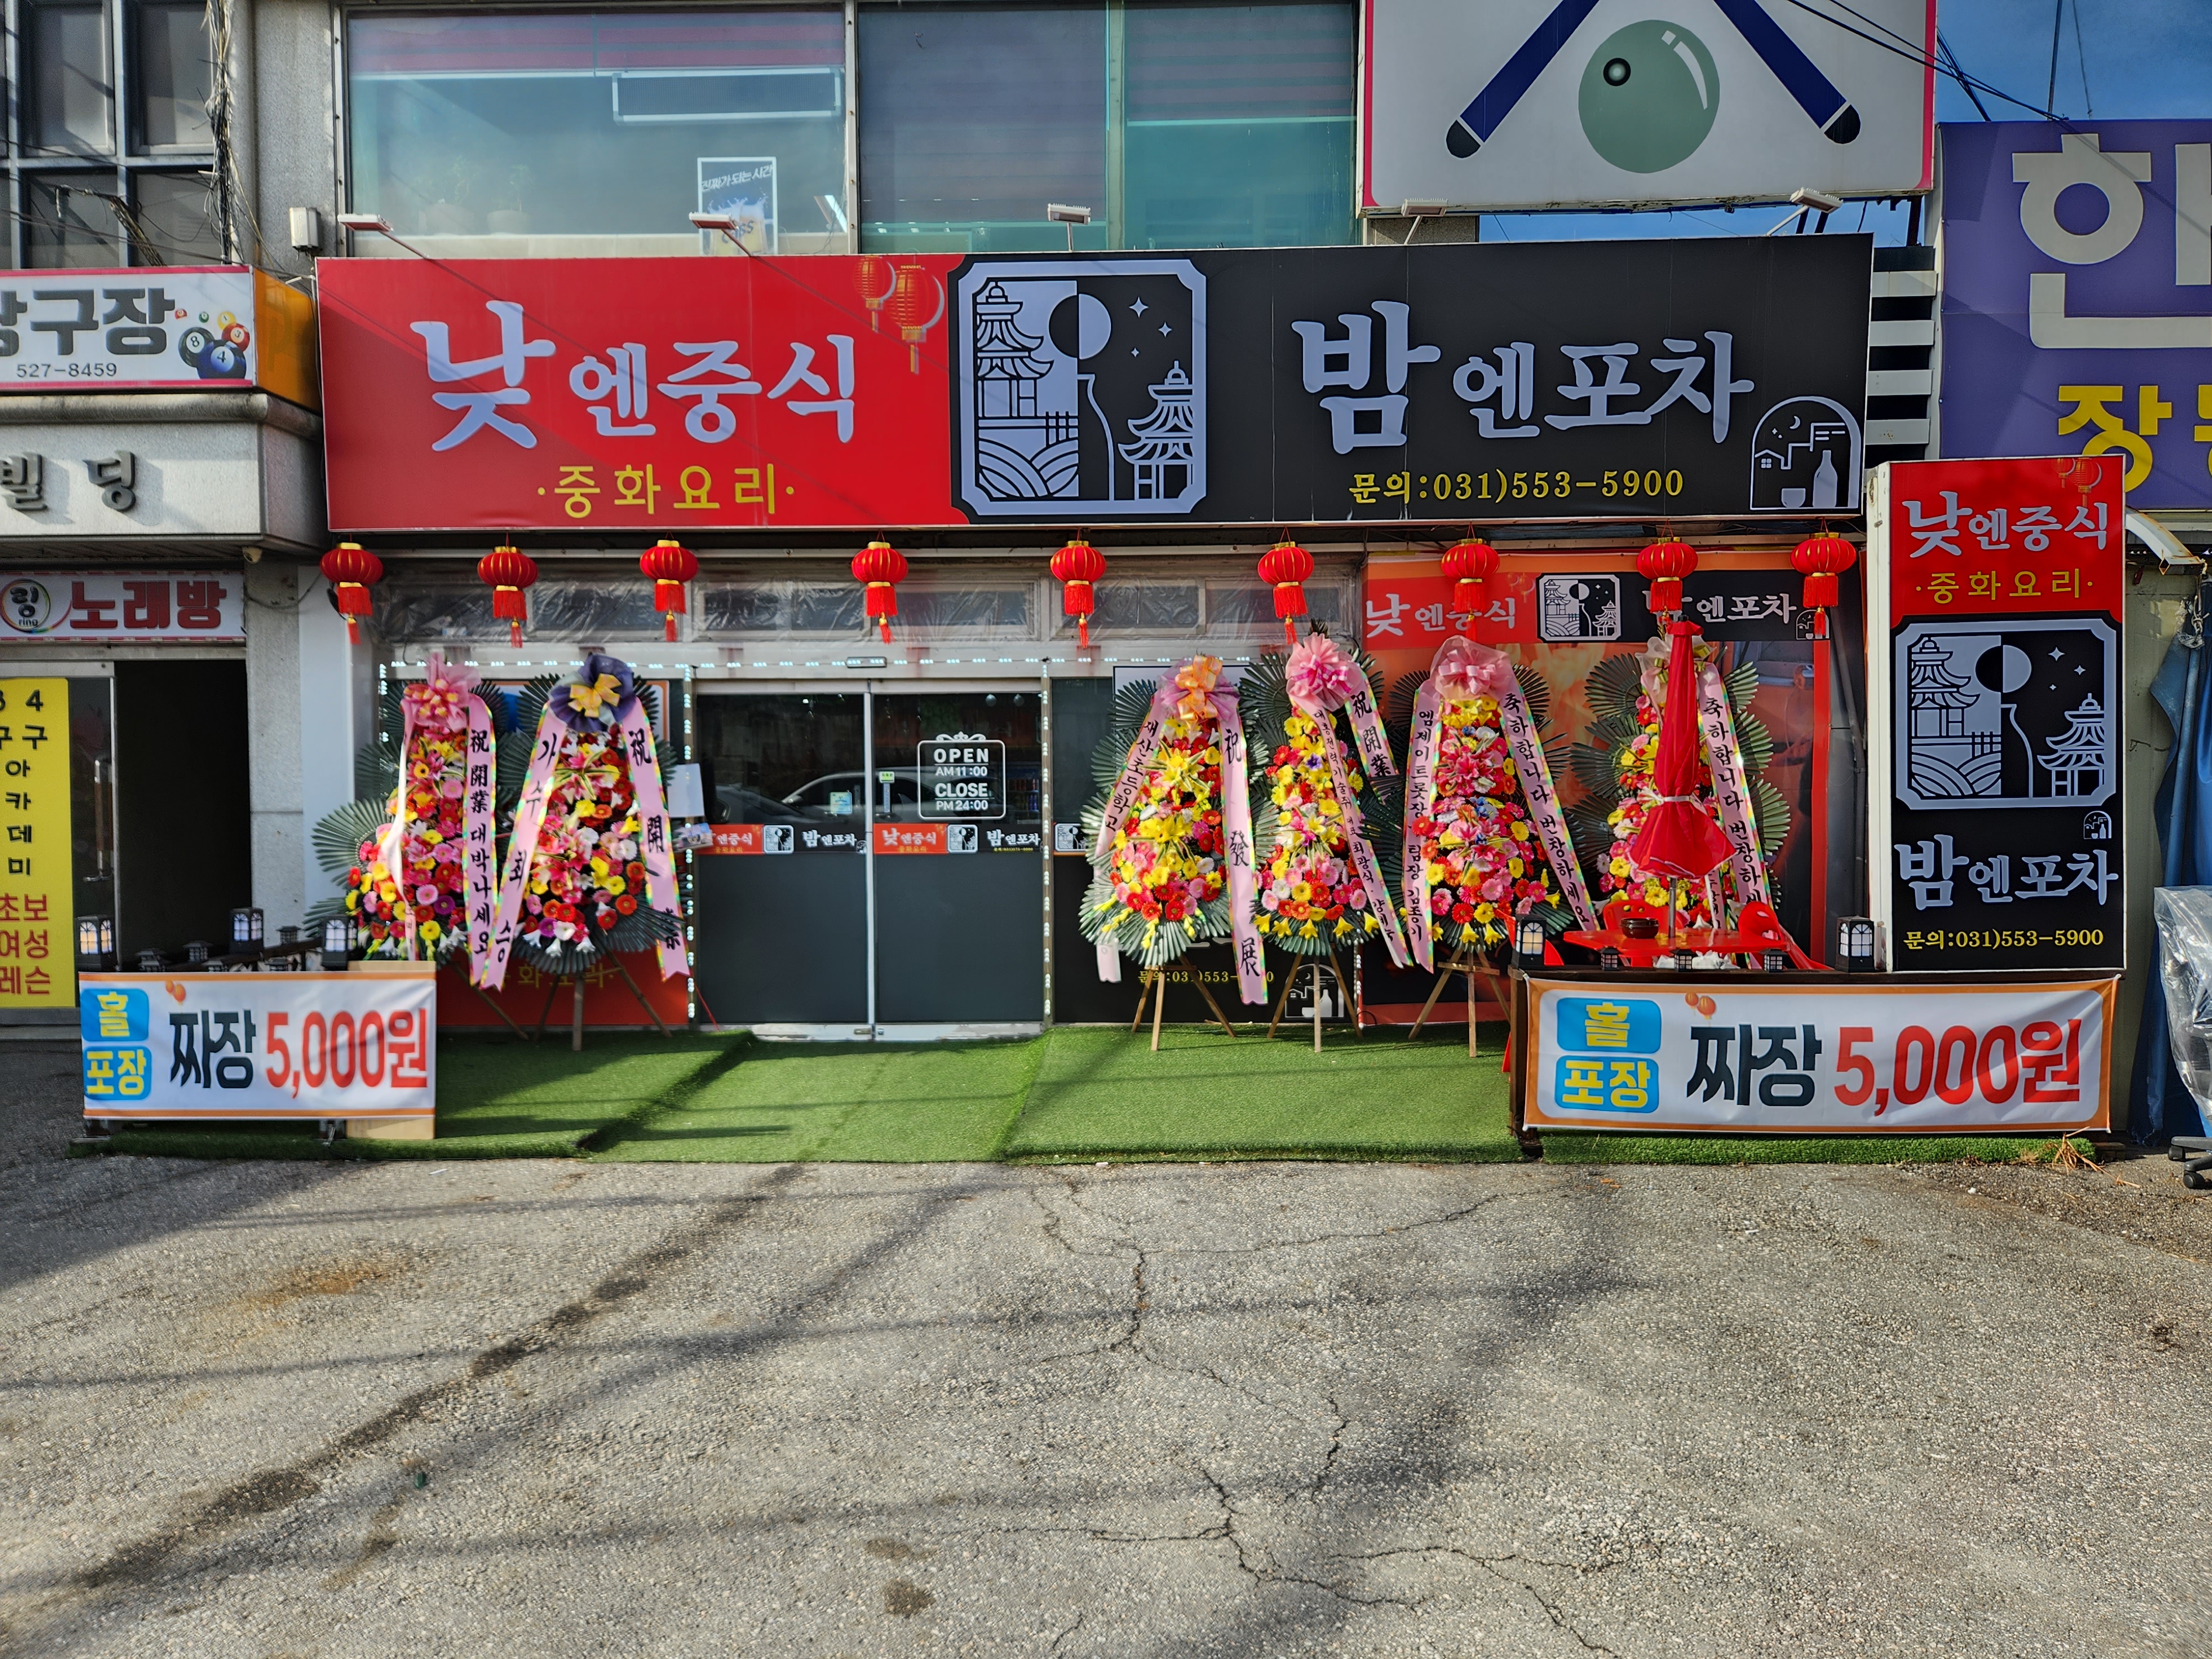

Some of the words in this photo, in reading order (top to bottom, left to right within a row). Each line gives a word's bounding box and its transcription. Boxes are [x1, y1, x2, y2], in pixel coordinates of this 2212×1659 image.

[16, 362, 118, 378] 527-8459
[1348, 469, 1684, 504] 문의:031)553-5900
[10, 588, 39, 618] 링
[70, 579, 227, 630] 노래방
[1642, 587, 1797, 625] 엔포차
[18, 618, 38, 628] ring
[933, 748, 989, 763] OPEN
[935, 766, 954, 776] AM
[935, 782, 988, 798] CLOSE
[936, 800, 954, 811] PM
[955, 800, 989, 811] 24:00
[1903, 929, 2104, 950] 문의:031)553-5900
[97, 991, 131, 1038] 홀
[1584, 1001, 1632, 1048] 홀
[169, 1009, 257, 1089] 짜장
[266, 1007, 428, 1098] 5,000원
[1686, 1024, 1823, 1107] 짜장
[1834, 1018, 2081, 1117] 5,000원
[86, 1050, 148, 1097] 포장
[1562, 1060, 1651, 1109] 포장
